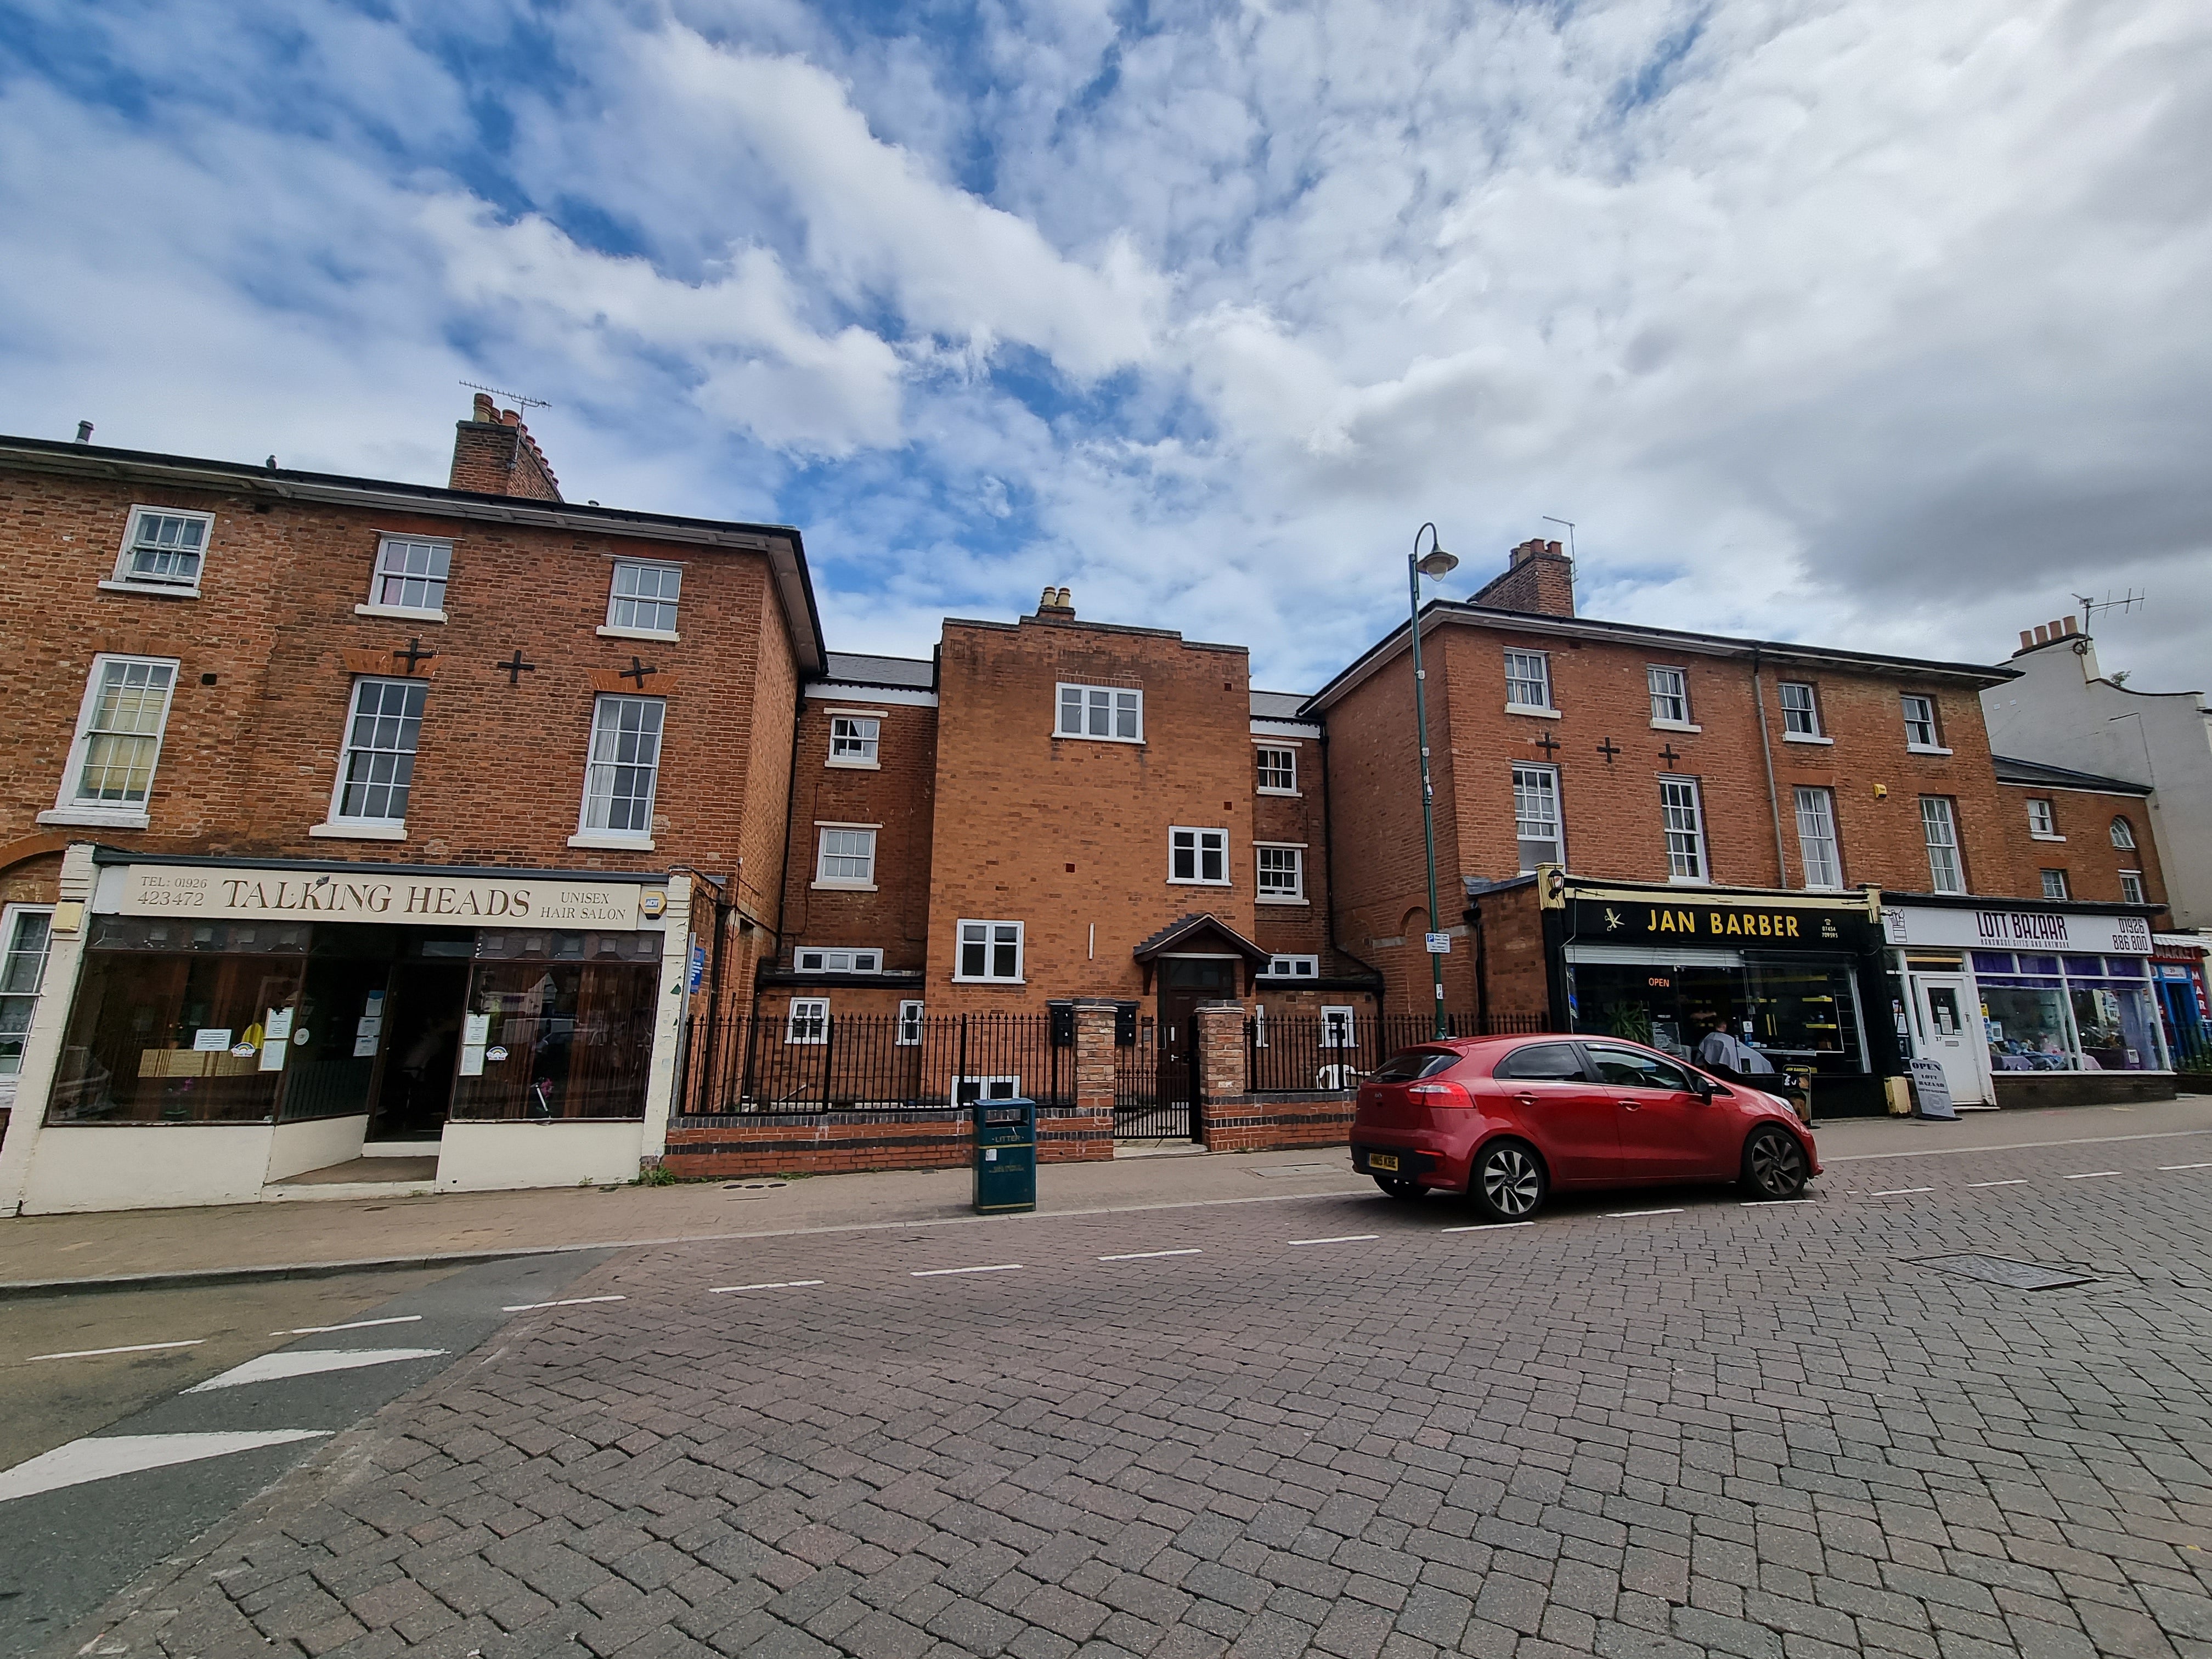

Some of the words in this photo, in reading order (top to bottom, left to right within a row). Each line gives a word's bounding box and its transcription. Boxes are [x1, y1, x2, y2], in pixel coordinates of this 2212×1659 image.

[141, 876, 170, 887] TEL:
[174, 877, 207, 888] 01926
[137, 890, 205, 906] 423472
[222, 879, 392, 913] TALKING
[403, 885, 531, 918] HEADS
[561, 892, 610, 904] UNISEX
[540, 907, 575, 918] HAIR
[580, 908, 627, 921] SALON
[1647, 909, 1695, 933] JAN
[1710, 912, 1799, 937] BARBER
[1976, 911, 2008, 938] LOTT
[2010, 913, 2068, 940] BAZAAR
[2118, 918, 2145, 934] 01926
[2112, 934, 2131, 950] 886
[2131, 935, 2149, 951] 800
[1649, 978, 1669, 988] OPEN
[1911, 1062, 1942, 1071] OPEN
